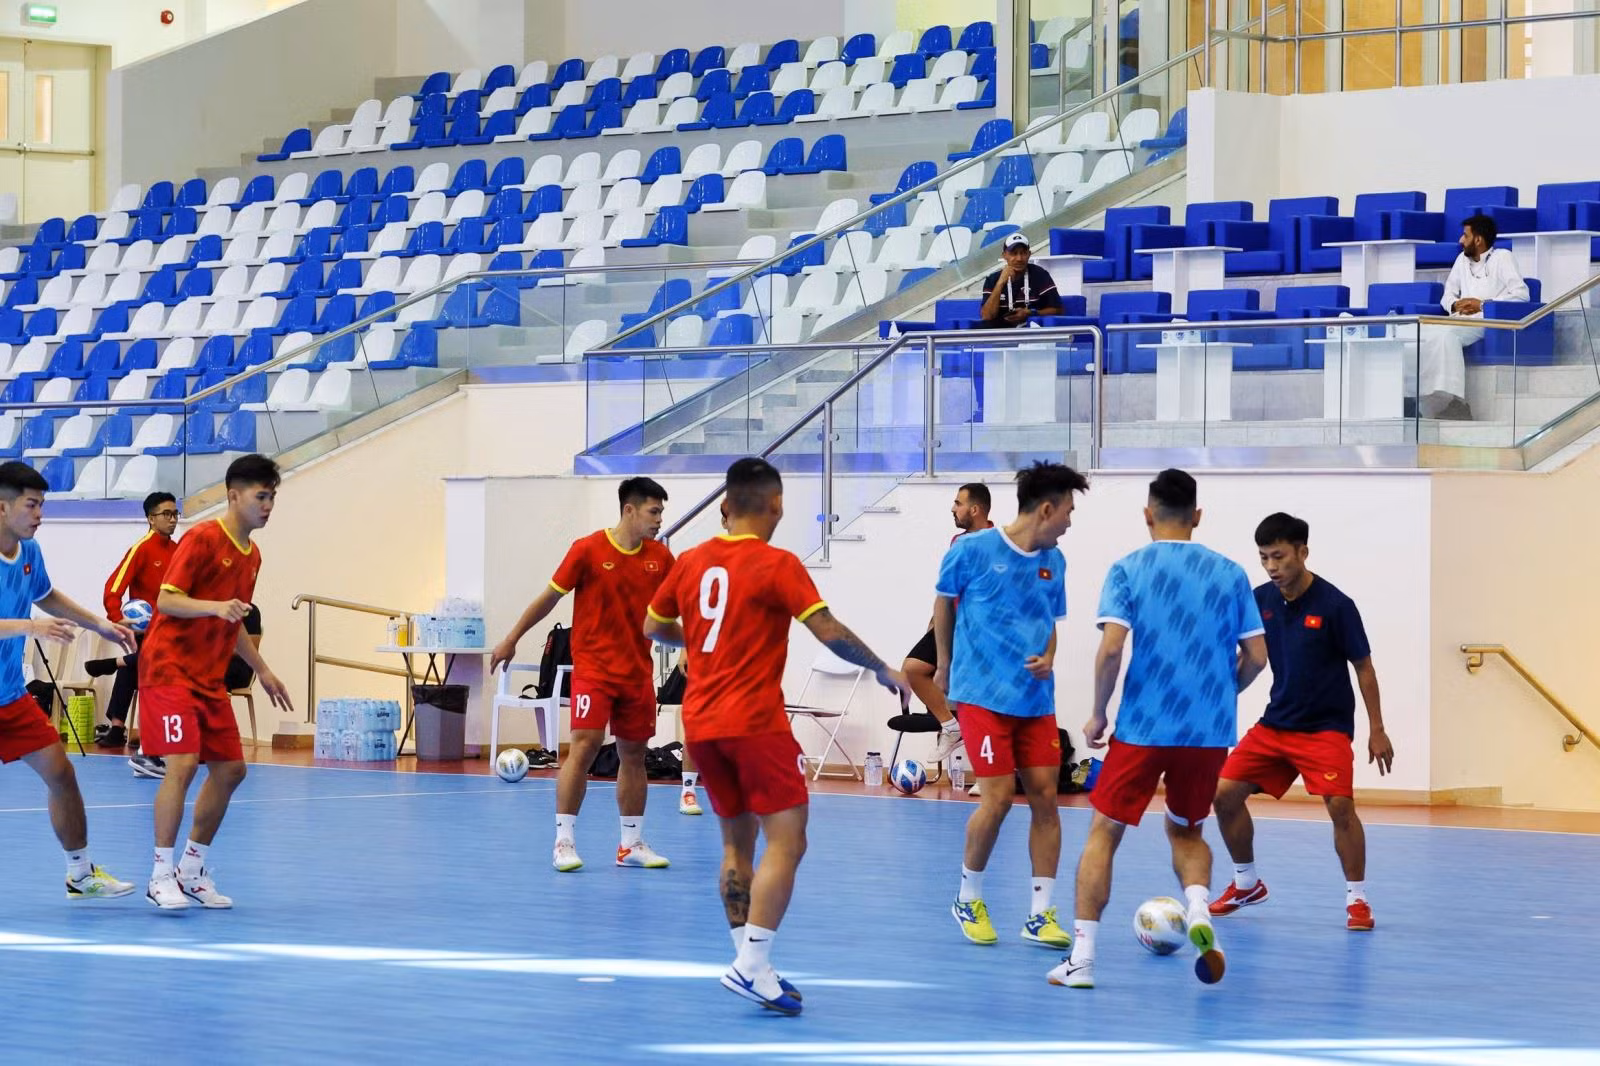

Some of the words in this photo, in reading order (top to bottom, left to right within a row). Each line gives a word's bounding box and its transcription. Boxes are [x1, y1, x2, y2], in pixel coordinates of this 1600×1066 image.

[700, 566, 729, 652] 9
[576, 694, 591, 718] 19
[162, 714, 183, 743] 13
[980, 735, 994, 764] 4
